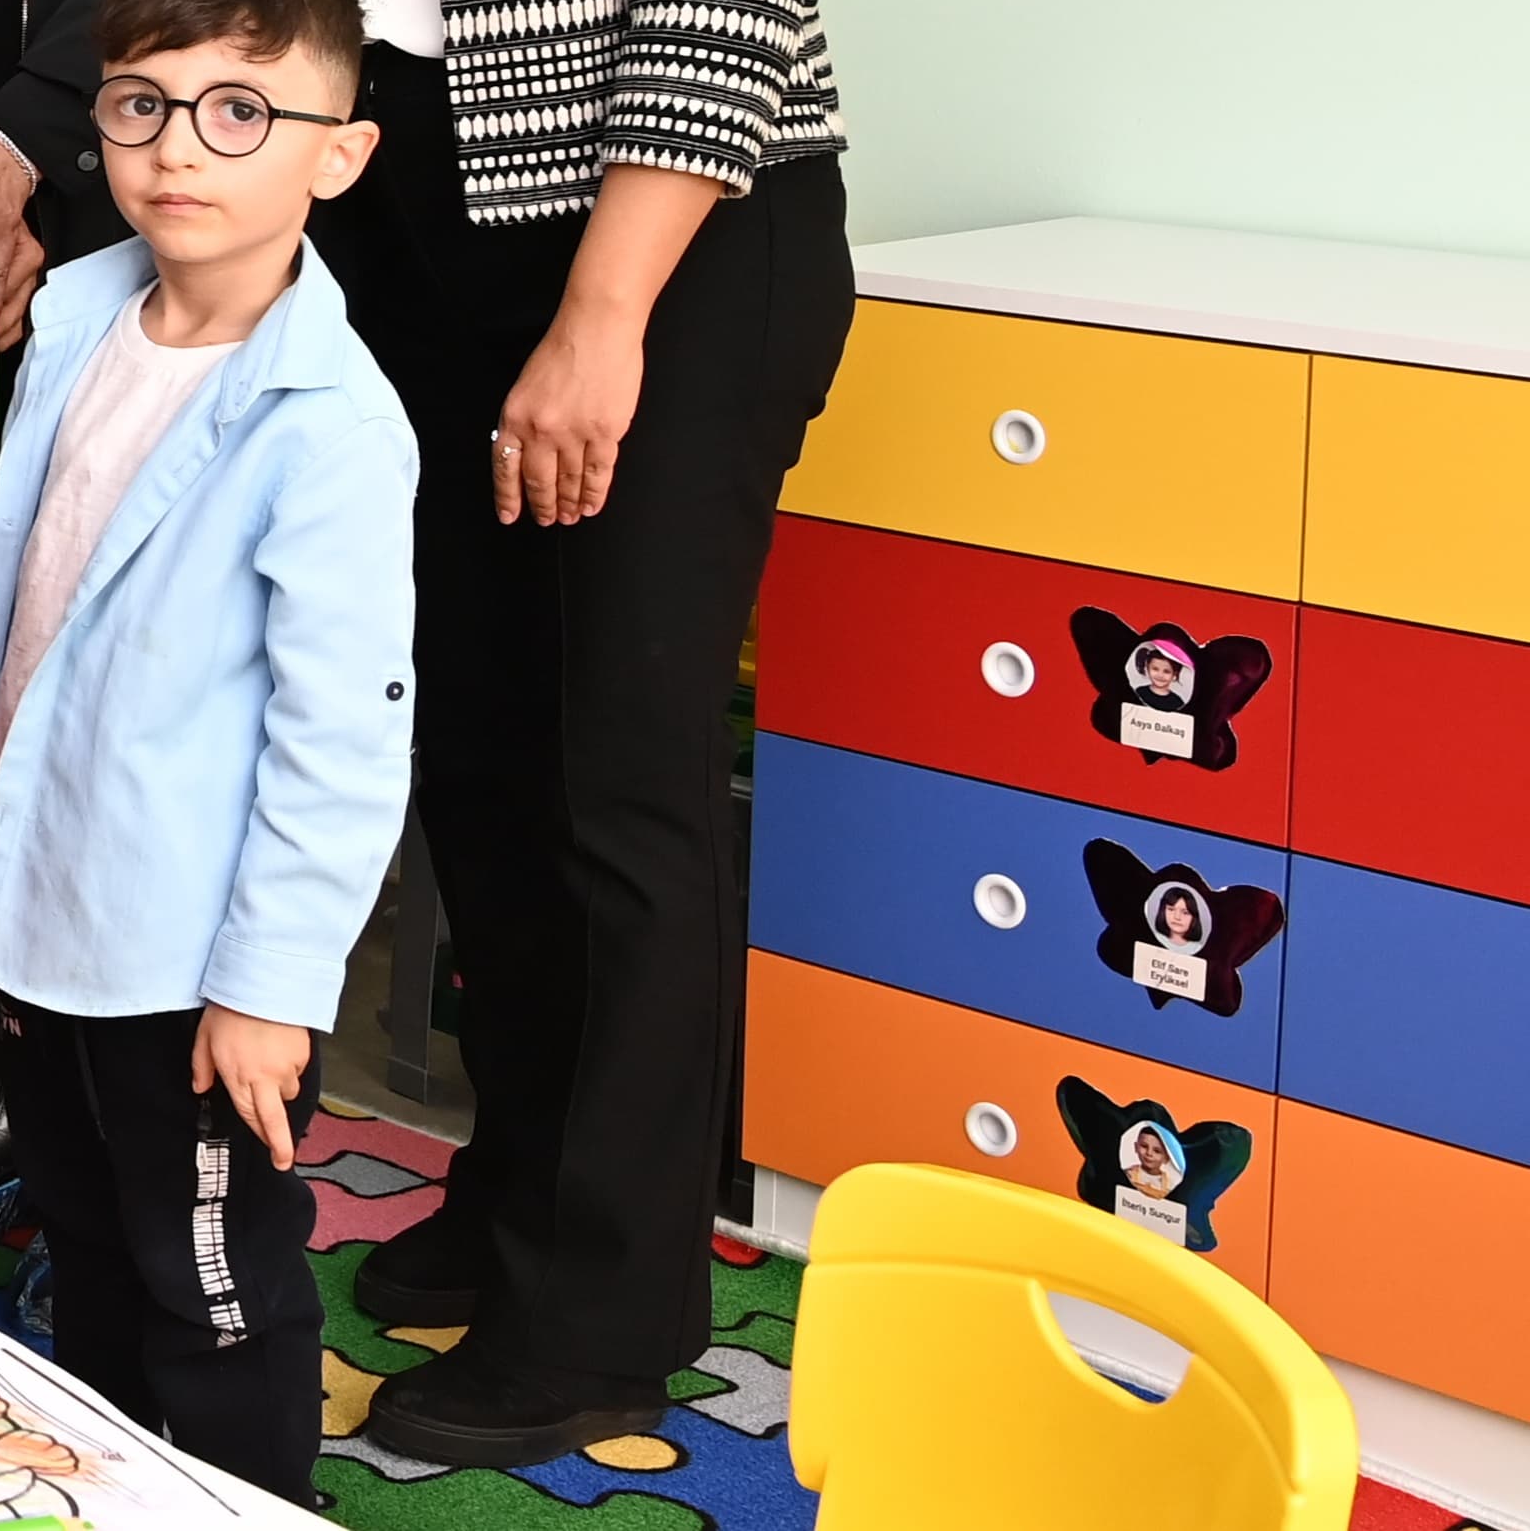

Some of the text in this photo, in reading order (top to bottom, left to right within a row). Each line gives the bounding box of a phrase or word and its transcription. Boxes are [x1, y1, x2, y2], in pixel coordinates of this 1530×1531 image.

[1151, 959, 1189, 976] Elif Sare
[1150, 971, 1189, 988] Eryüksel
